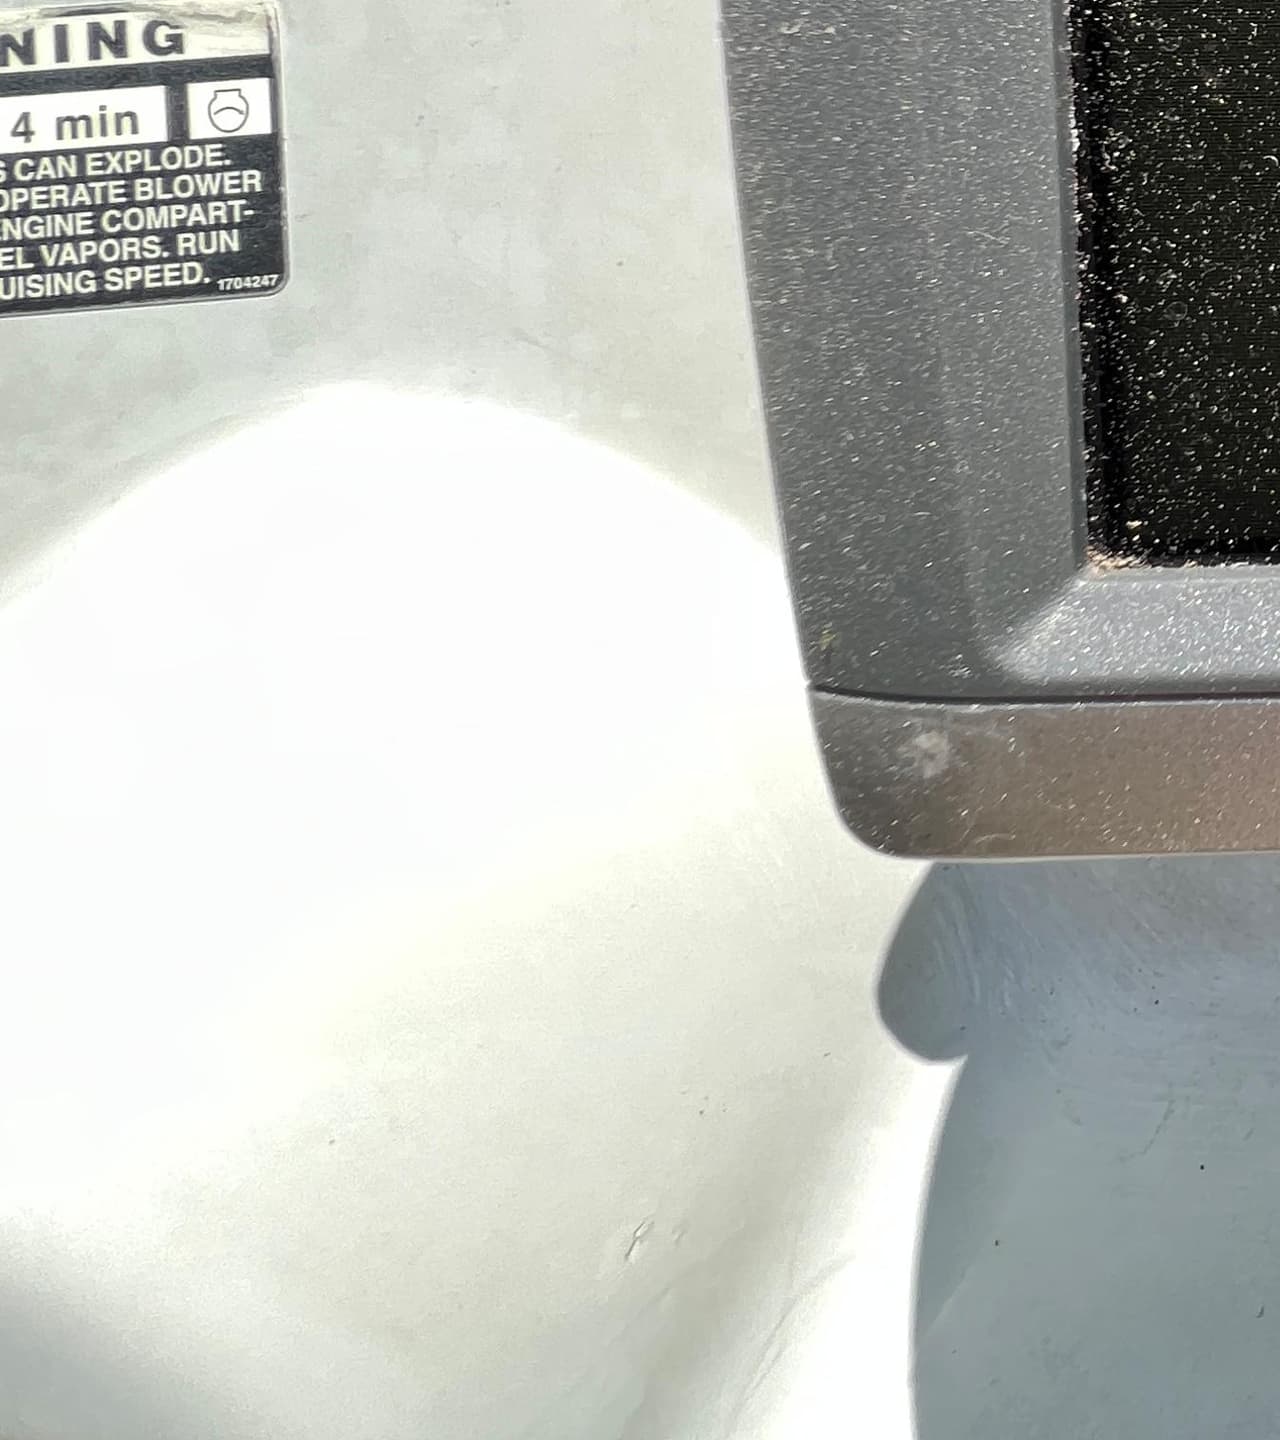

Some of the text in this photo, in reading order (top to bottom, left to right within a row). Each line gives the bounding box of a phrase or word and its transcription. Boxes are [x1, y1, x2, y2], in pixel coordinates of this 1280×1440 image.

[10, 104, 140, 144] 4 min
[13, 154, 79, 181] CAN
[85, 143, 232, 177] EXPLODE.
[134, 169, 263, 202] BLOWER
[1, 198, 255, 241] NGINE COMPART-
[39, 234, 170, 267] VAPORS.
[176, 228, 241, 257] RUN
[104, 261, 212, 292] SPEED.
[217, 273, 280, 292] 1704247
